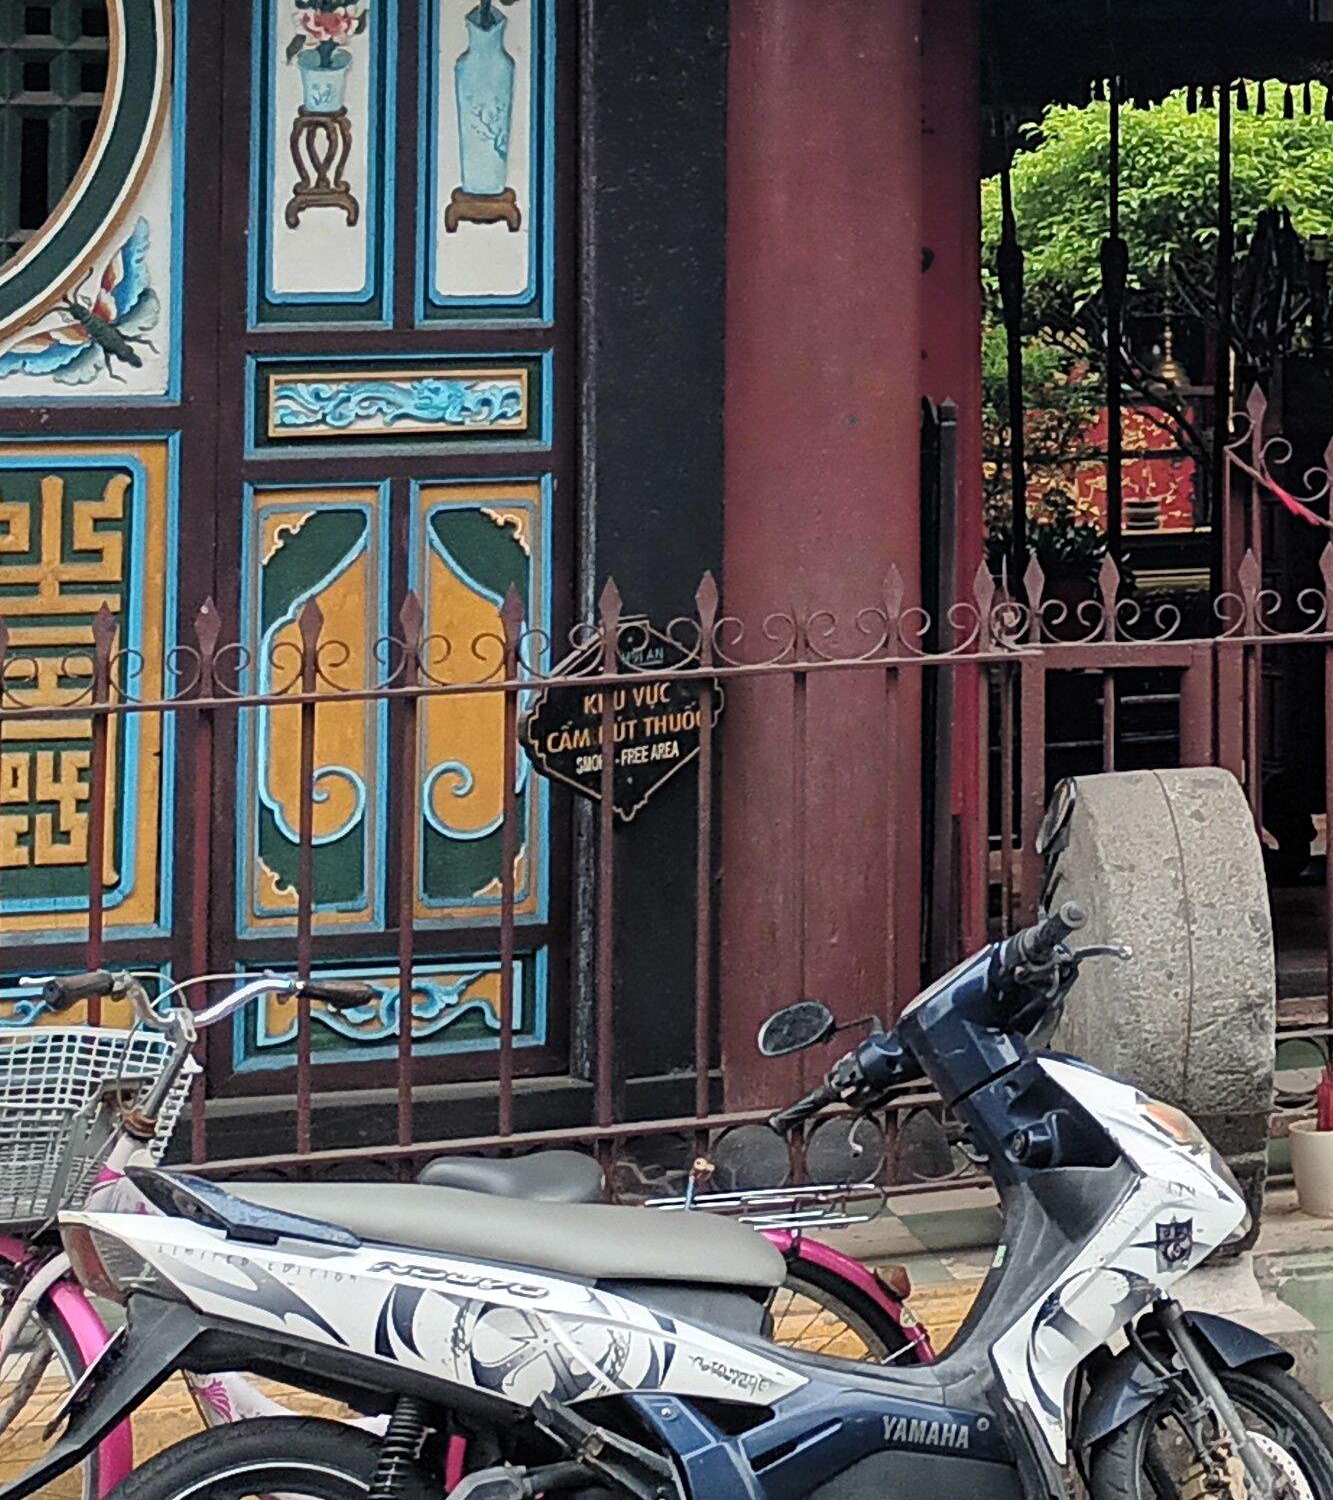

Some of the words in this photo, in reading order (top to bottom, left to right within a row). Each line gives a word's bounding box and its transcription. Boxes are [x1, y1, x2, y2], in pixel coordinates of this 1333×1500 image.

[633, 682, 671, 710] VỰC
[547, 720, 591, 753] CẤM
[651, 740, 680, 761] AREA
[882, 1414, 970, 1449] YAMAHA
